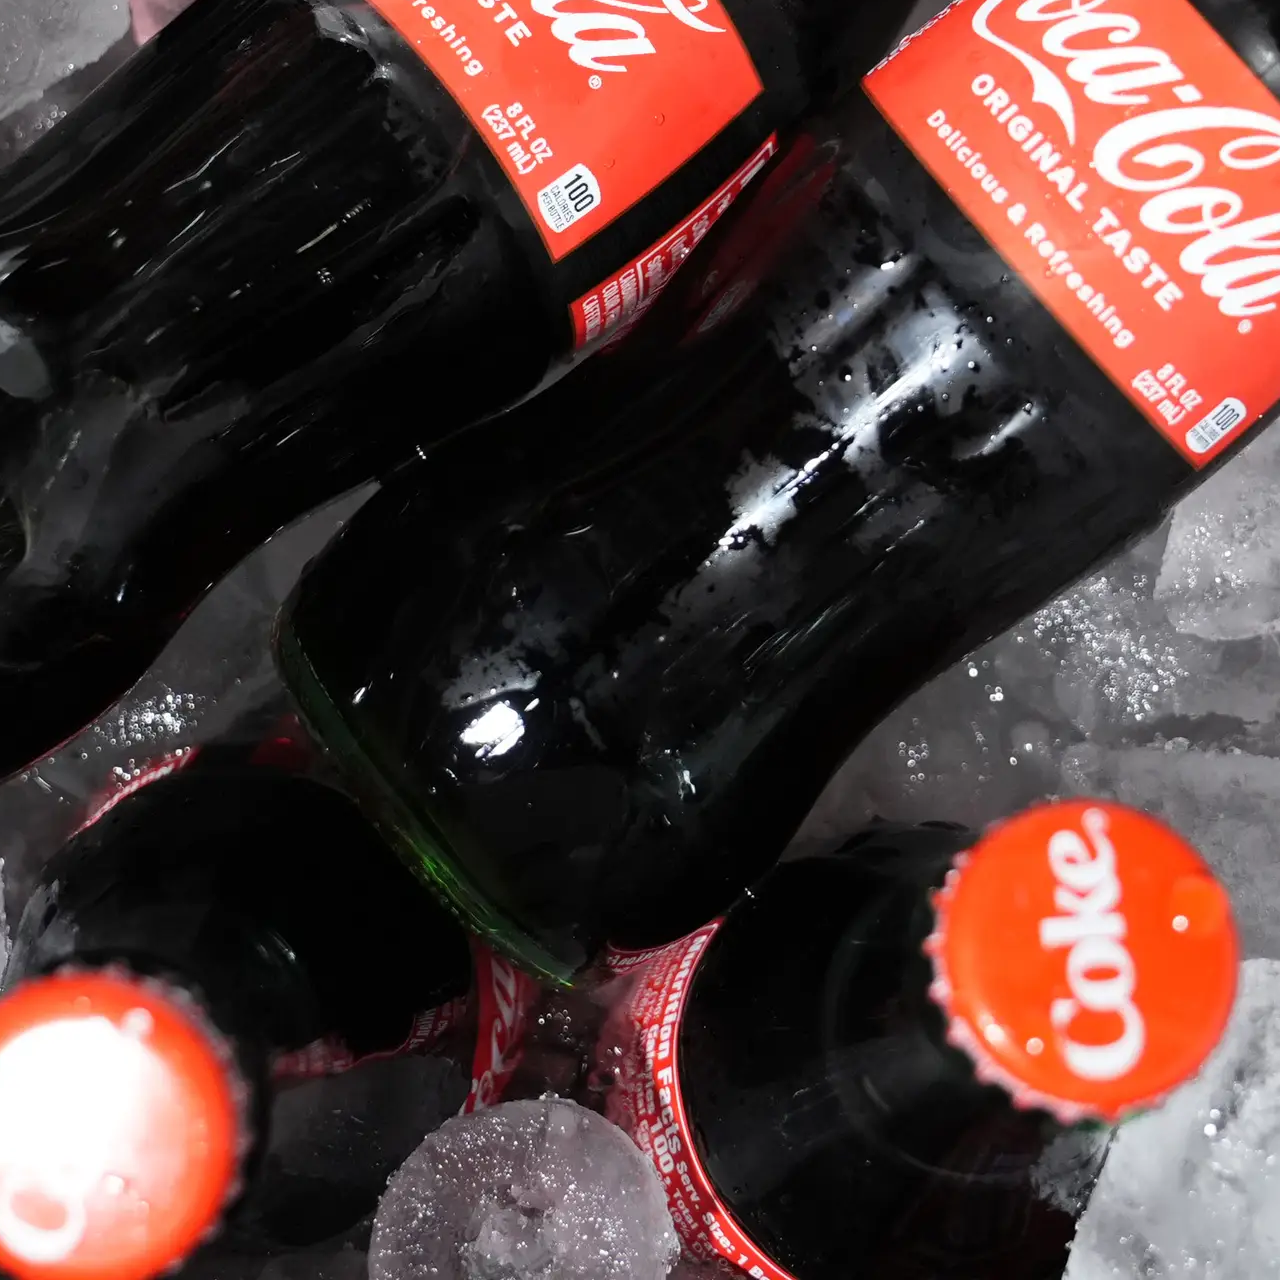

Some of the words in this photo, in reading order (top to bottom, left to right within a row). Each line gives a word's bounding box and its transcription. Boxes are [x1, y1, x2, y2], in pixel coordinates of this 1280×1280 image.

[481, 104, 516, 140] (237
[507, 141, 538, 175] mL)
[506, 102, 523, 118] 8
[515, 114, 536, 141] FL
[530, 137, 553, 164] OZ
[550, 185, 575, 223] CALORIES
[564, 173, 594, 213] 100
[970, 73, 1090, 212] ORIGINAL
[1093, 207, 1184, 311] TASTE
[927, 109, 1010, 205] Delicious
[1007, 203, 1028, 226] &
[1024, 221, 1136, 350] Refreshing
[1156, 363, 1175, 381] 8
[1212, 404, 1240, 431] 100
[1039, 829, 1148, 1082] Coke
[662, 934, 708, 1060] Nutrition
[657, 1065, 681, 1153] Facts
[702, 1211, 736, 1255] Size:
